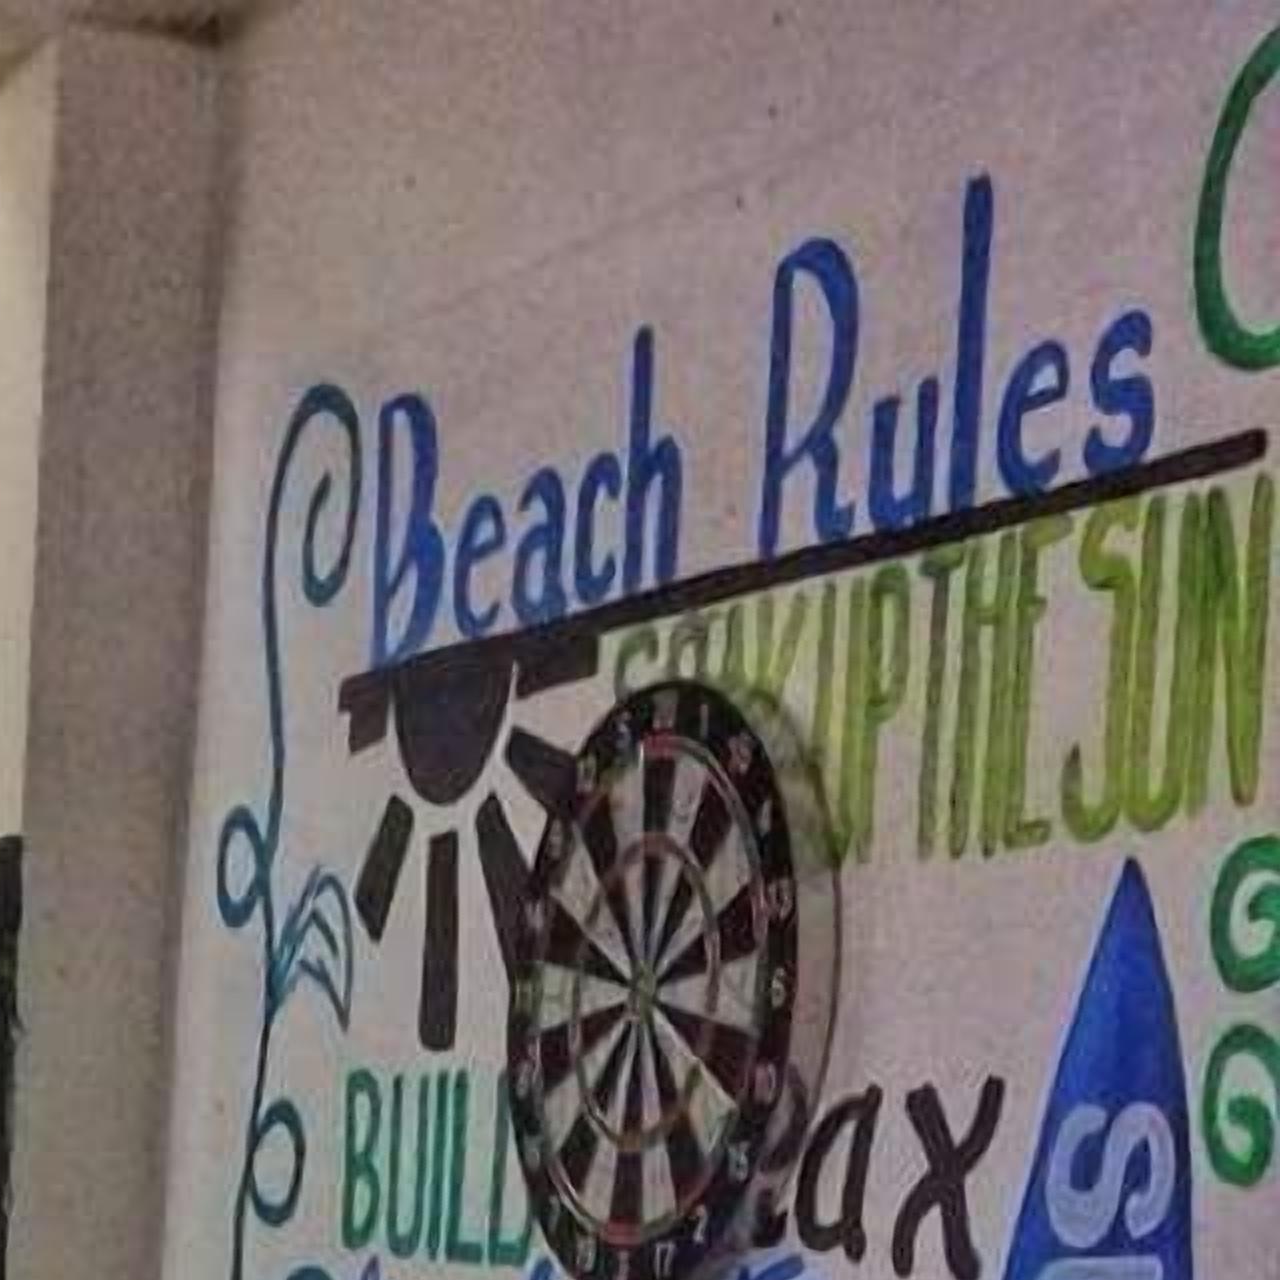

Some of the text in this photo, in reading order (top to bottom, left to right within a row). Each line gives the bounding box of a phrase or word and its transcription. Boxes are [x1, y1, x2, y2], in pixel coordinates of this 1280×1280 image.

[372, 171, 1156, 671] Beach Rules
[916, 511, 1074, 860] THE
[1060, 472, 1276, 843] SUN
